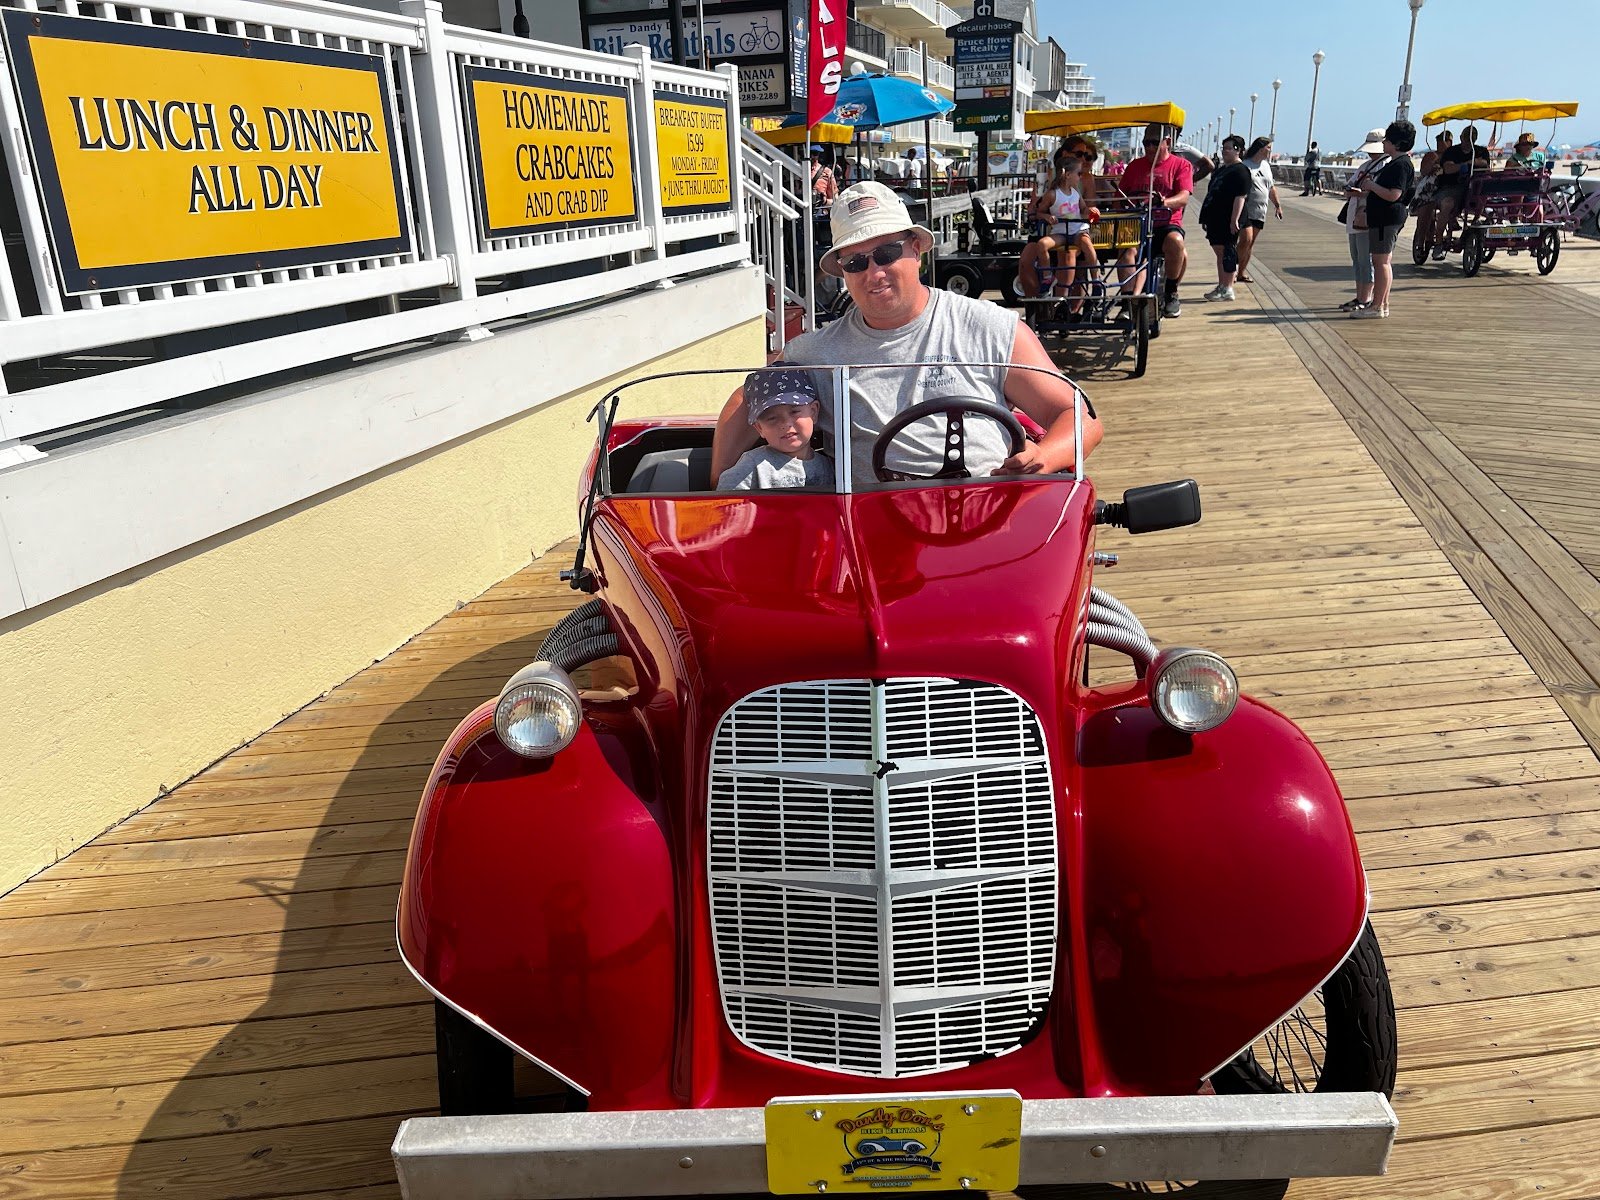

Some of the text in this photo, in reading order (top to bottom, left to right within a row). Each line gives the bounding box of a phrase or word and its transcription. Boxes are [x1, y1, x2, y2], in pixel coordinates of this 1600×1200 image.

[629, 22, 662, 34] Dandy
[956, 22, 1012, 33] decatur house
[957, 37, 1013, 47] Bruce Howe
[970, 44, 999, 53] Realty
[976, 63, 995, 72] AVAIL
[987, 70, 1009, 78] AGENTS
[738, 68, 775, 82] ANANA
[738, 80, 769, 93] BIKES
[502, 89, 611, 133] HOMEMADE
[67, 96, 382, 153] LUNCH & DINNER
[659, 107, 723, 131] BREAKFAST BUFFET
[965, 114, 1001, 125] SUBWAY
[687, 133, 704, 153] 15.99
[515, 143, 615, 182] CRABCAKES
[671, 156, 697, 171] MONDAY
[701, 156, 720, 171] FRIDAY
[187, 164, 324, 214] ALL DAY
[668, 178, 725, 200] JUNE THRU AUGUST
[525, 188, 609, 219] AND CRAB DIP
[937, 376, 956, 388] COUNTY
[837, 1107, 945, 1133] Dandy Don's
[885, 1126, 927, 1135] RENTALS
